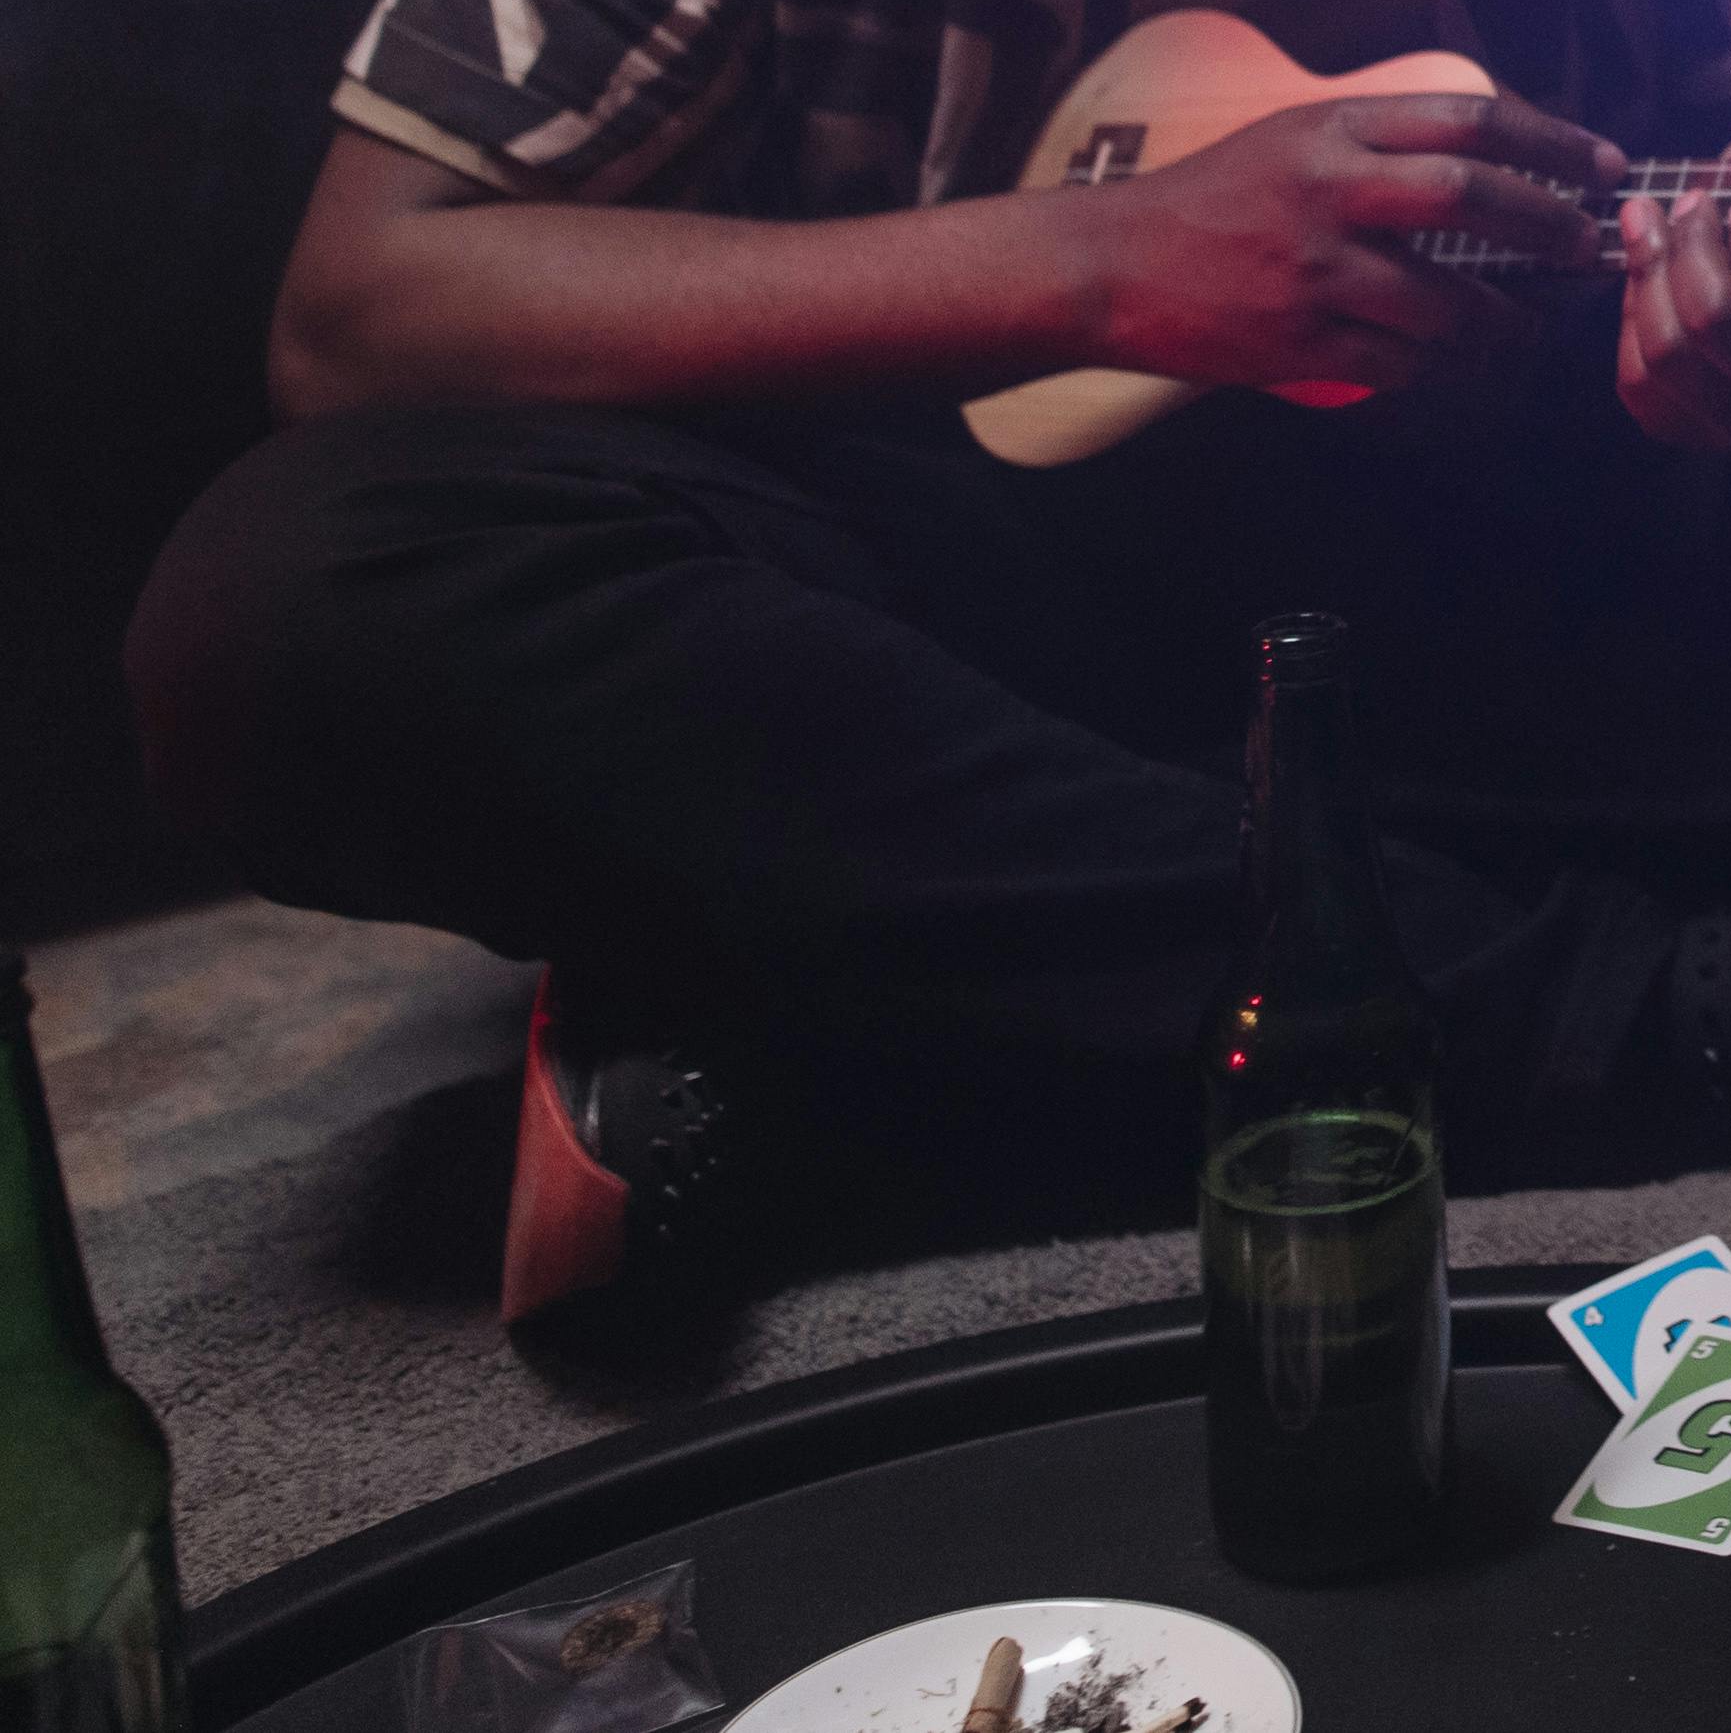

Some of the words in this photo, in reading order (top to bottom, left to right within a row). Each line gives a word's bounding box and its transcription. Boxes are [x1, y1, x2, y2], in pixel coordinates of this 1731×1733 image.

[1584, 1306, 1604, 1326] 4
[1691, 1340, 1719, 1360] 5
[1701, 1517, 1731, 1538] 5
